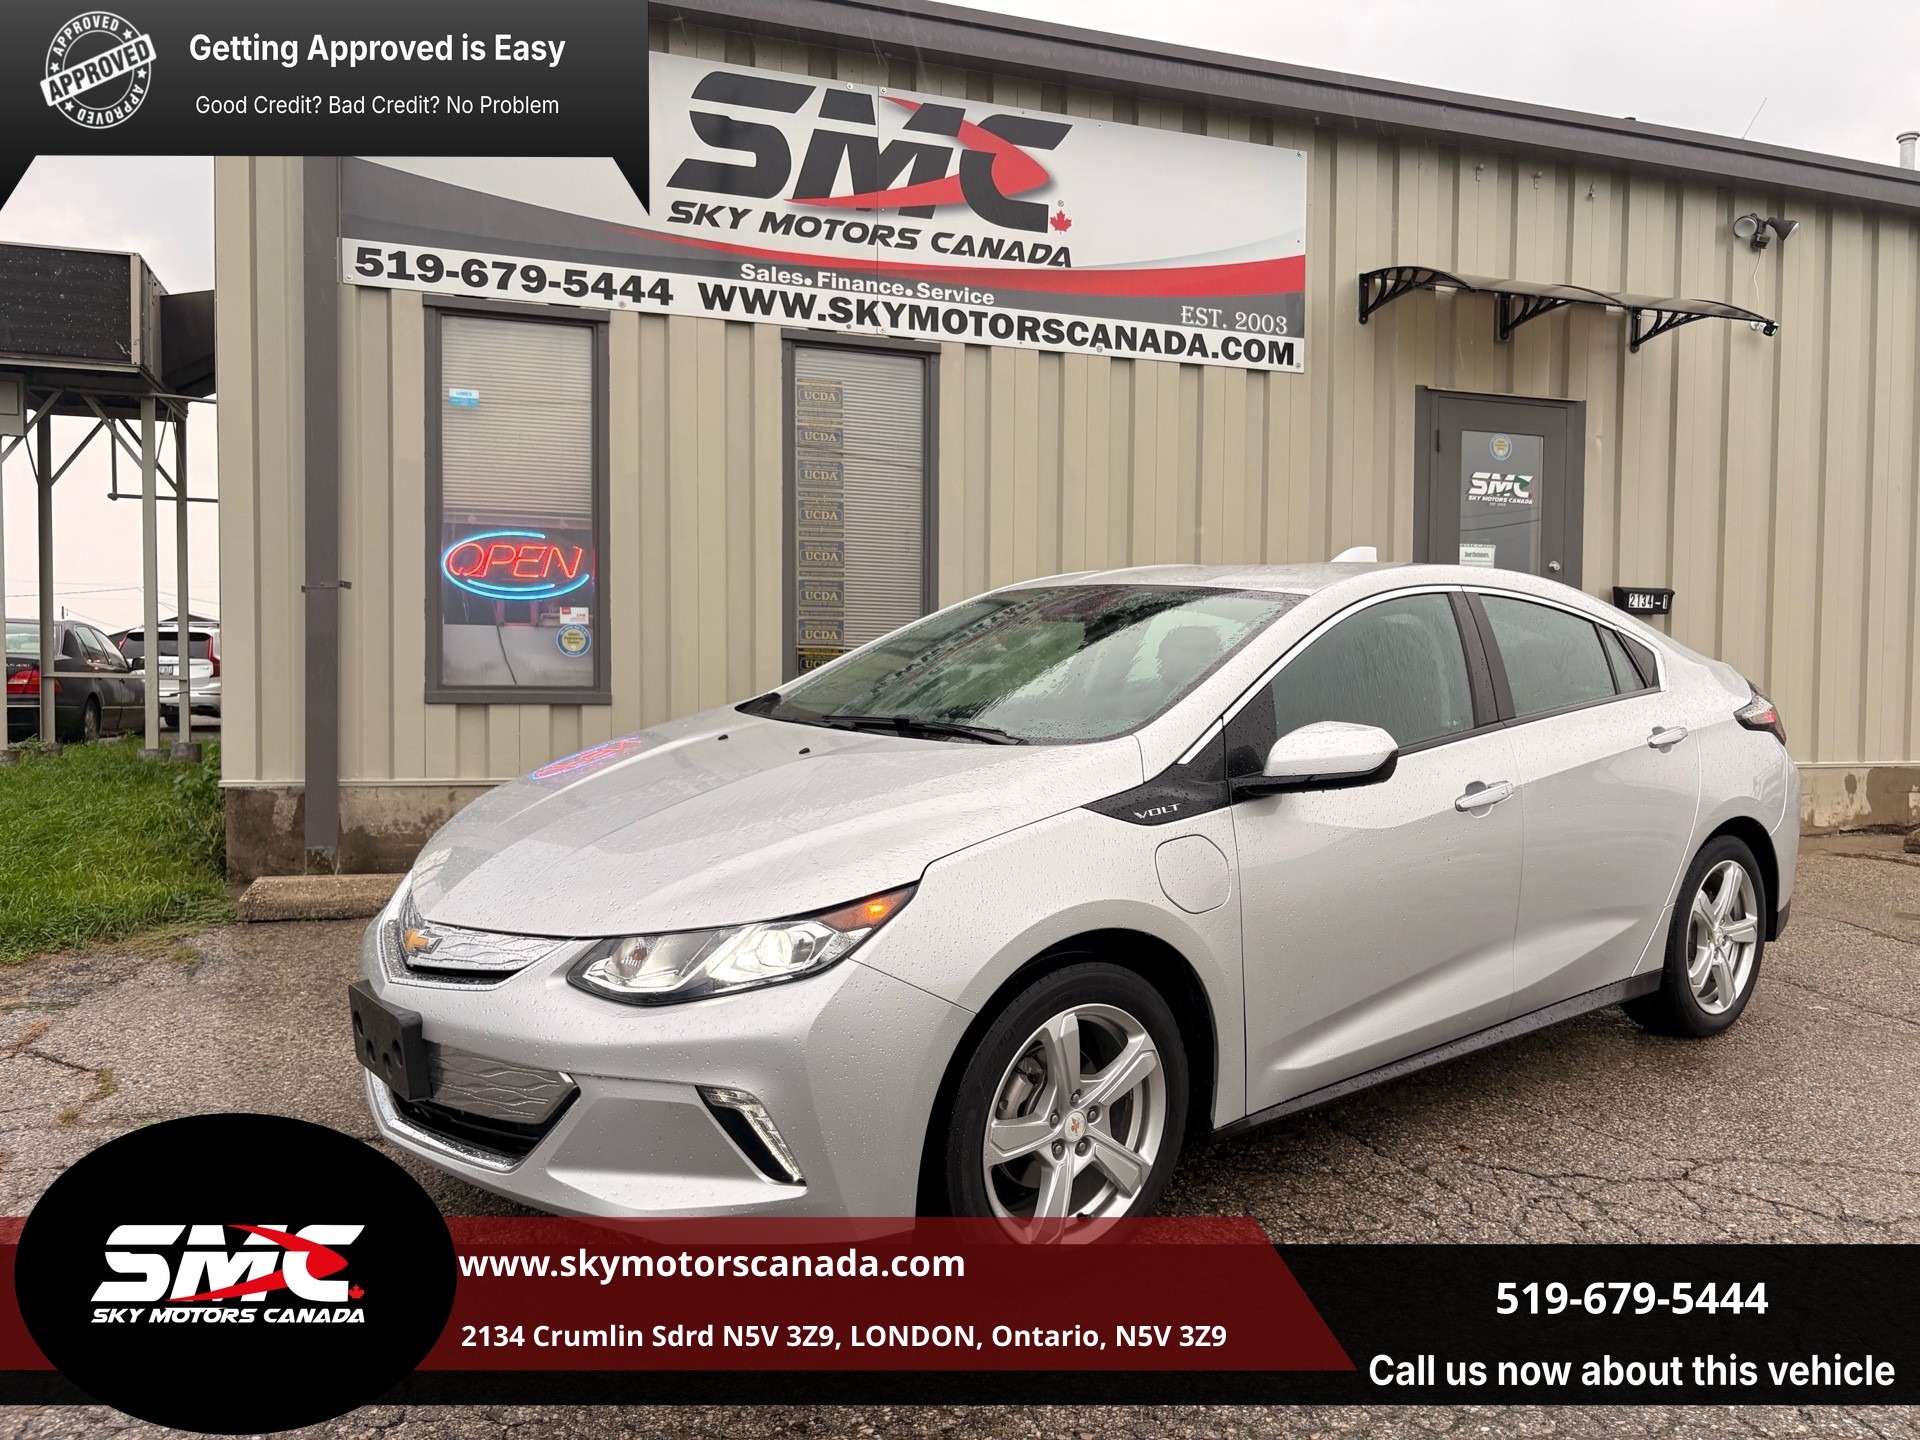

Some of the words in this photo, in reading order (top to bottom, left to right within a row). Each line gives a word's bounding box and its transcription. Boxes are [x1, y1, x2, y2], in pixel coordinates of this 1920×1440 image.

[667, 71, 1073, 234] SMC
[666, 200, 754, 230] SKY
[758, 211, 923, 251] MOTORS
[930, 231, 1072, 268] CANADA
[354, 246, 675, 307] 519-679-5444
[916, 282, 995, 306] Service
[696, 281, 1296, 367] WWW.SKYMOTORSCANADA.COM
[1180, 305, 1228, 329] EST.
[1235, 311, 1288, 335] 2003
[804, 390, 837, 401] UCDA
[804, 431, 837, 441] UCDA
[804, 470, 838, 481] UCDA
[1468, 472, 1533, 498] SMC
[804, 510, 839, 521] UCDA
[447, 543, 583, 578] OPEN
[805, 551, 839, 561] UCDA
[805, 591, 839, 601] UCDA
[805, 630, 838, 640] UCDA
[1133, 803, 1180, 819] VOLT
